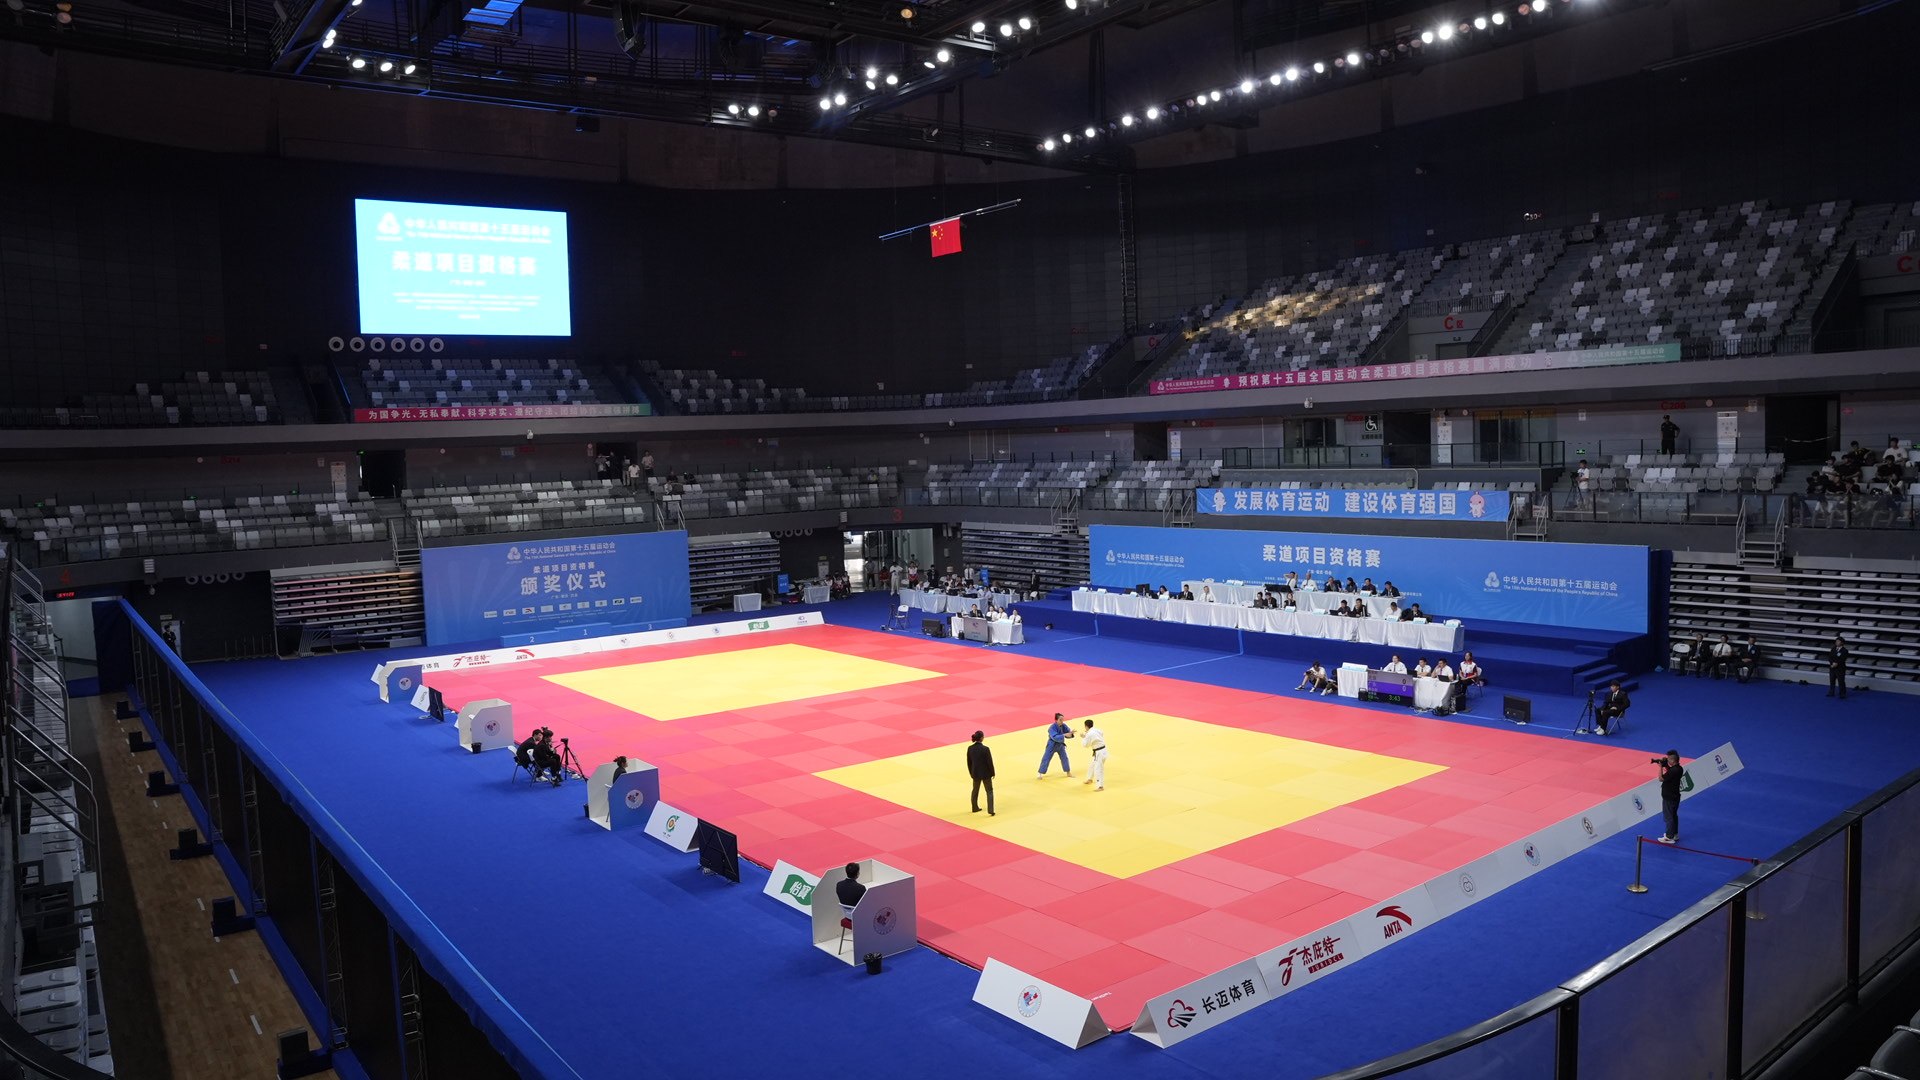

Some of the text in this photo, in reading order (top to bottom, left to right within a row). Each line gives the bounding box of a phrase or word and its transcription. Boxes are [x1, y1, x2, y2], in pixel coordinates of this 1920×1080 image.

[1896, 255, 1920, 273] C
[1233, 491, 1457, 515] 发展体育运动 建设体育强国
[523, 542, 616, 555] 中华人民共和国第十五届运动会
[1262, 544, 1381, 568] 柔道项目资格赛
[533, 561, 595, 574] 柔道项目资格赛
[521, 570, 606, 595] 颁奖仪式
[1503, 575, 1618, 591] 中华人民共和国第十五届运动会
[1383, 920, 1402, 939] ANTA
[1297, 936, 1341, 966] 杰庇特
[1201, 978, 1257, 1015] 长迈体育
